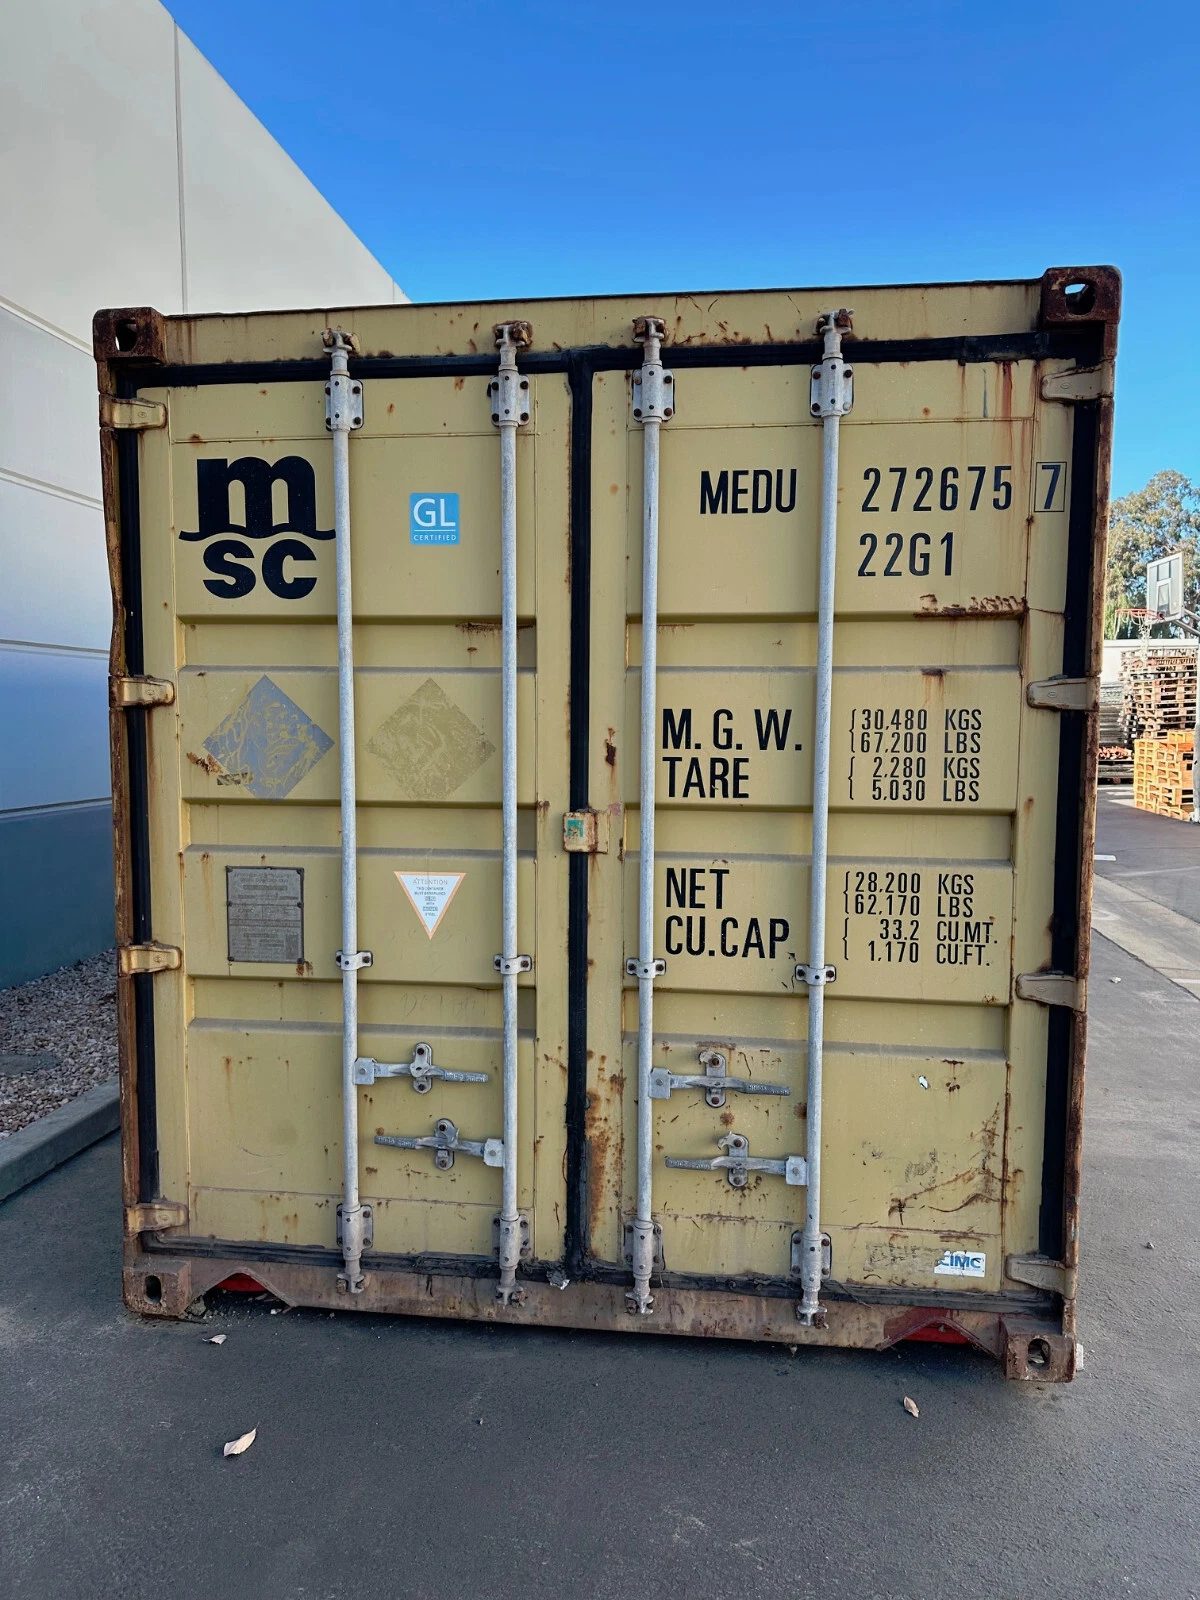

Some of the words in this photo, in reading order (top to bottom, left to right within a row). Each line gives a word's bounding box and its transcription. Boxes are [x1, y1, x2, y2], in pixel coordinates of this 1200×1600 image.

[699, 468, 797, 515] MEDU
[861, 465, 1012, 512] 272675
[1041, 464, 1062, 510] 7
[413, 498, 456, 527] GL
[857, 531, 954, 577] 22G1
[861, 708, 928, 731] 30,480
[944, 708, 982, 731] KGS
[860, 731, 927, 754] 67,200
[944, 731, 981, 754] LBS
[662, 756, 750, 799] TARE
[872, 756, 926, 779] 2,280
[943, 756, 980, 780] KGS
[872, 779, 926, 802] 5,030
[942, 779, 980, 802] LBS
[665, 867, 730, 910] NET
[855, 871, 921, 894] 28,200
[937, 873, 974, 896] KGS
[854, 893, 920, 917] 62,170
[937, 896, 974, 919] LBS
[879, 918, 920, 941] 33.2
[936, 920, 998, 945] CU.MT.
[868, 940, 919, 964] 1,170
[936, 942, 991, 967] CU.FT.
